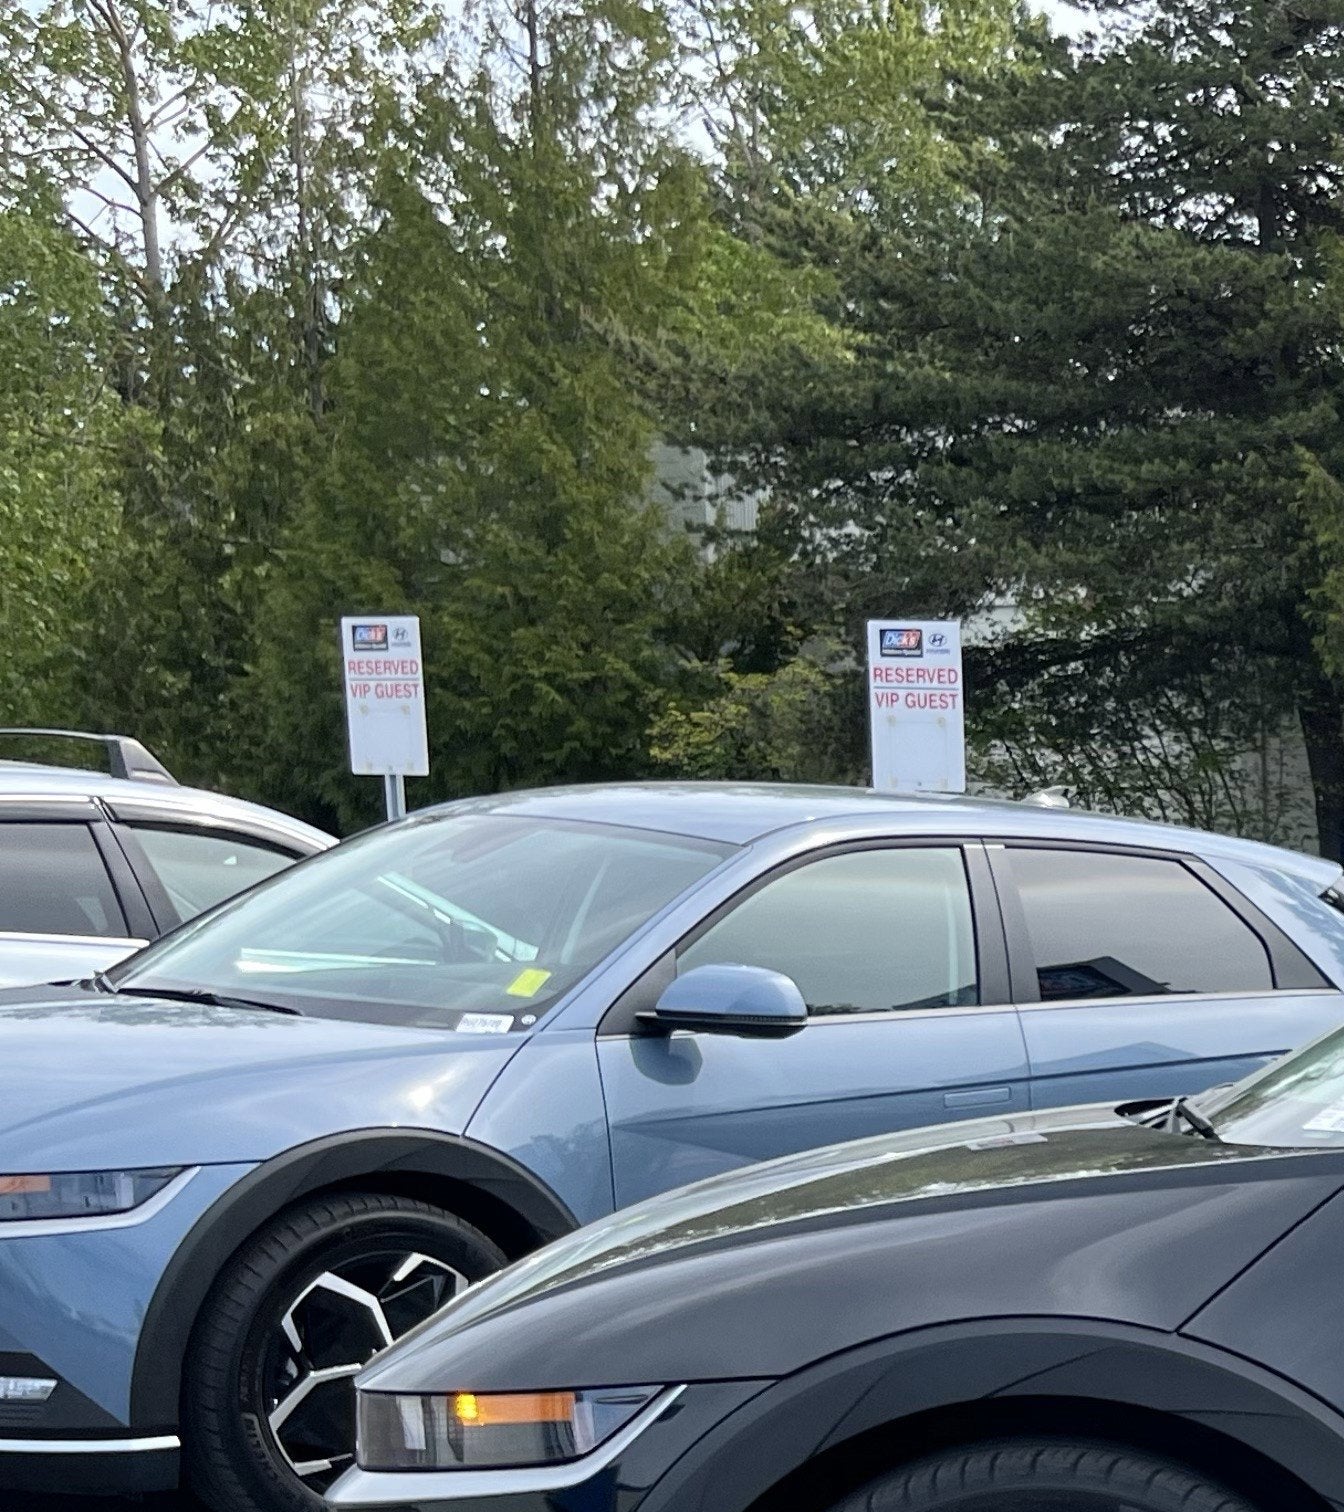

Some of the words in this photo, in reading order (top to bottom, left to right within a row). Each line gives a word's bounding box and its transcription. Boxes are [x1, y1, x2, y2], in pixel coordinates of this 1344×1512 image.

[348, 659, 419, 676] RESERVED
[873, 667, 958, 684] RESERVED
[351, 683, 370, 699] VIP
[375, 683, 419, 699] GUEST
[875, 692, 899, 708] VIP
[905, 693, 959, 709] GUEST
